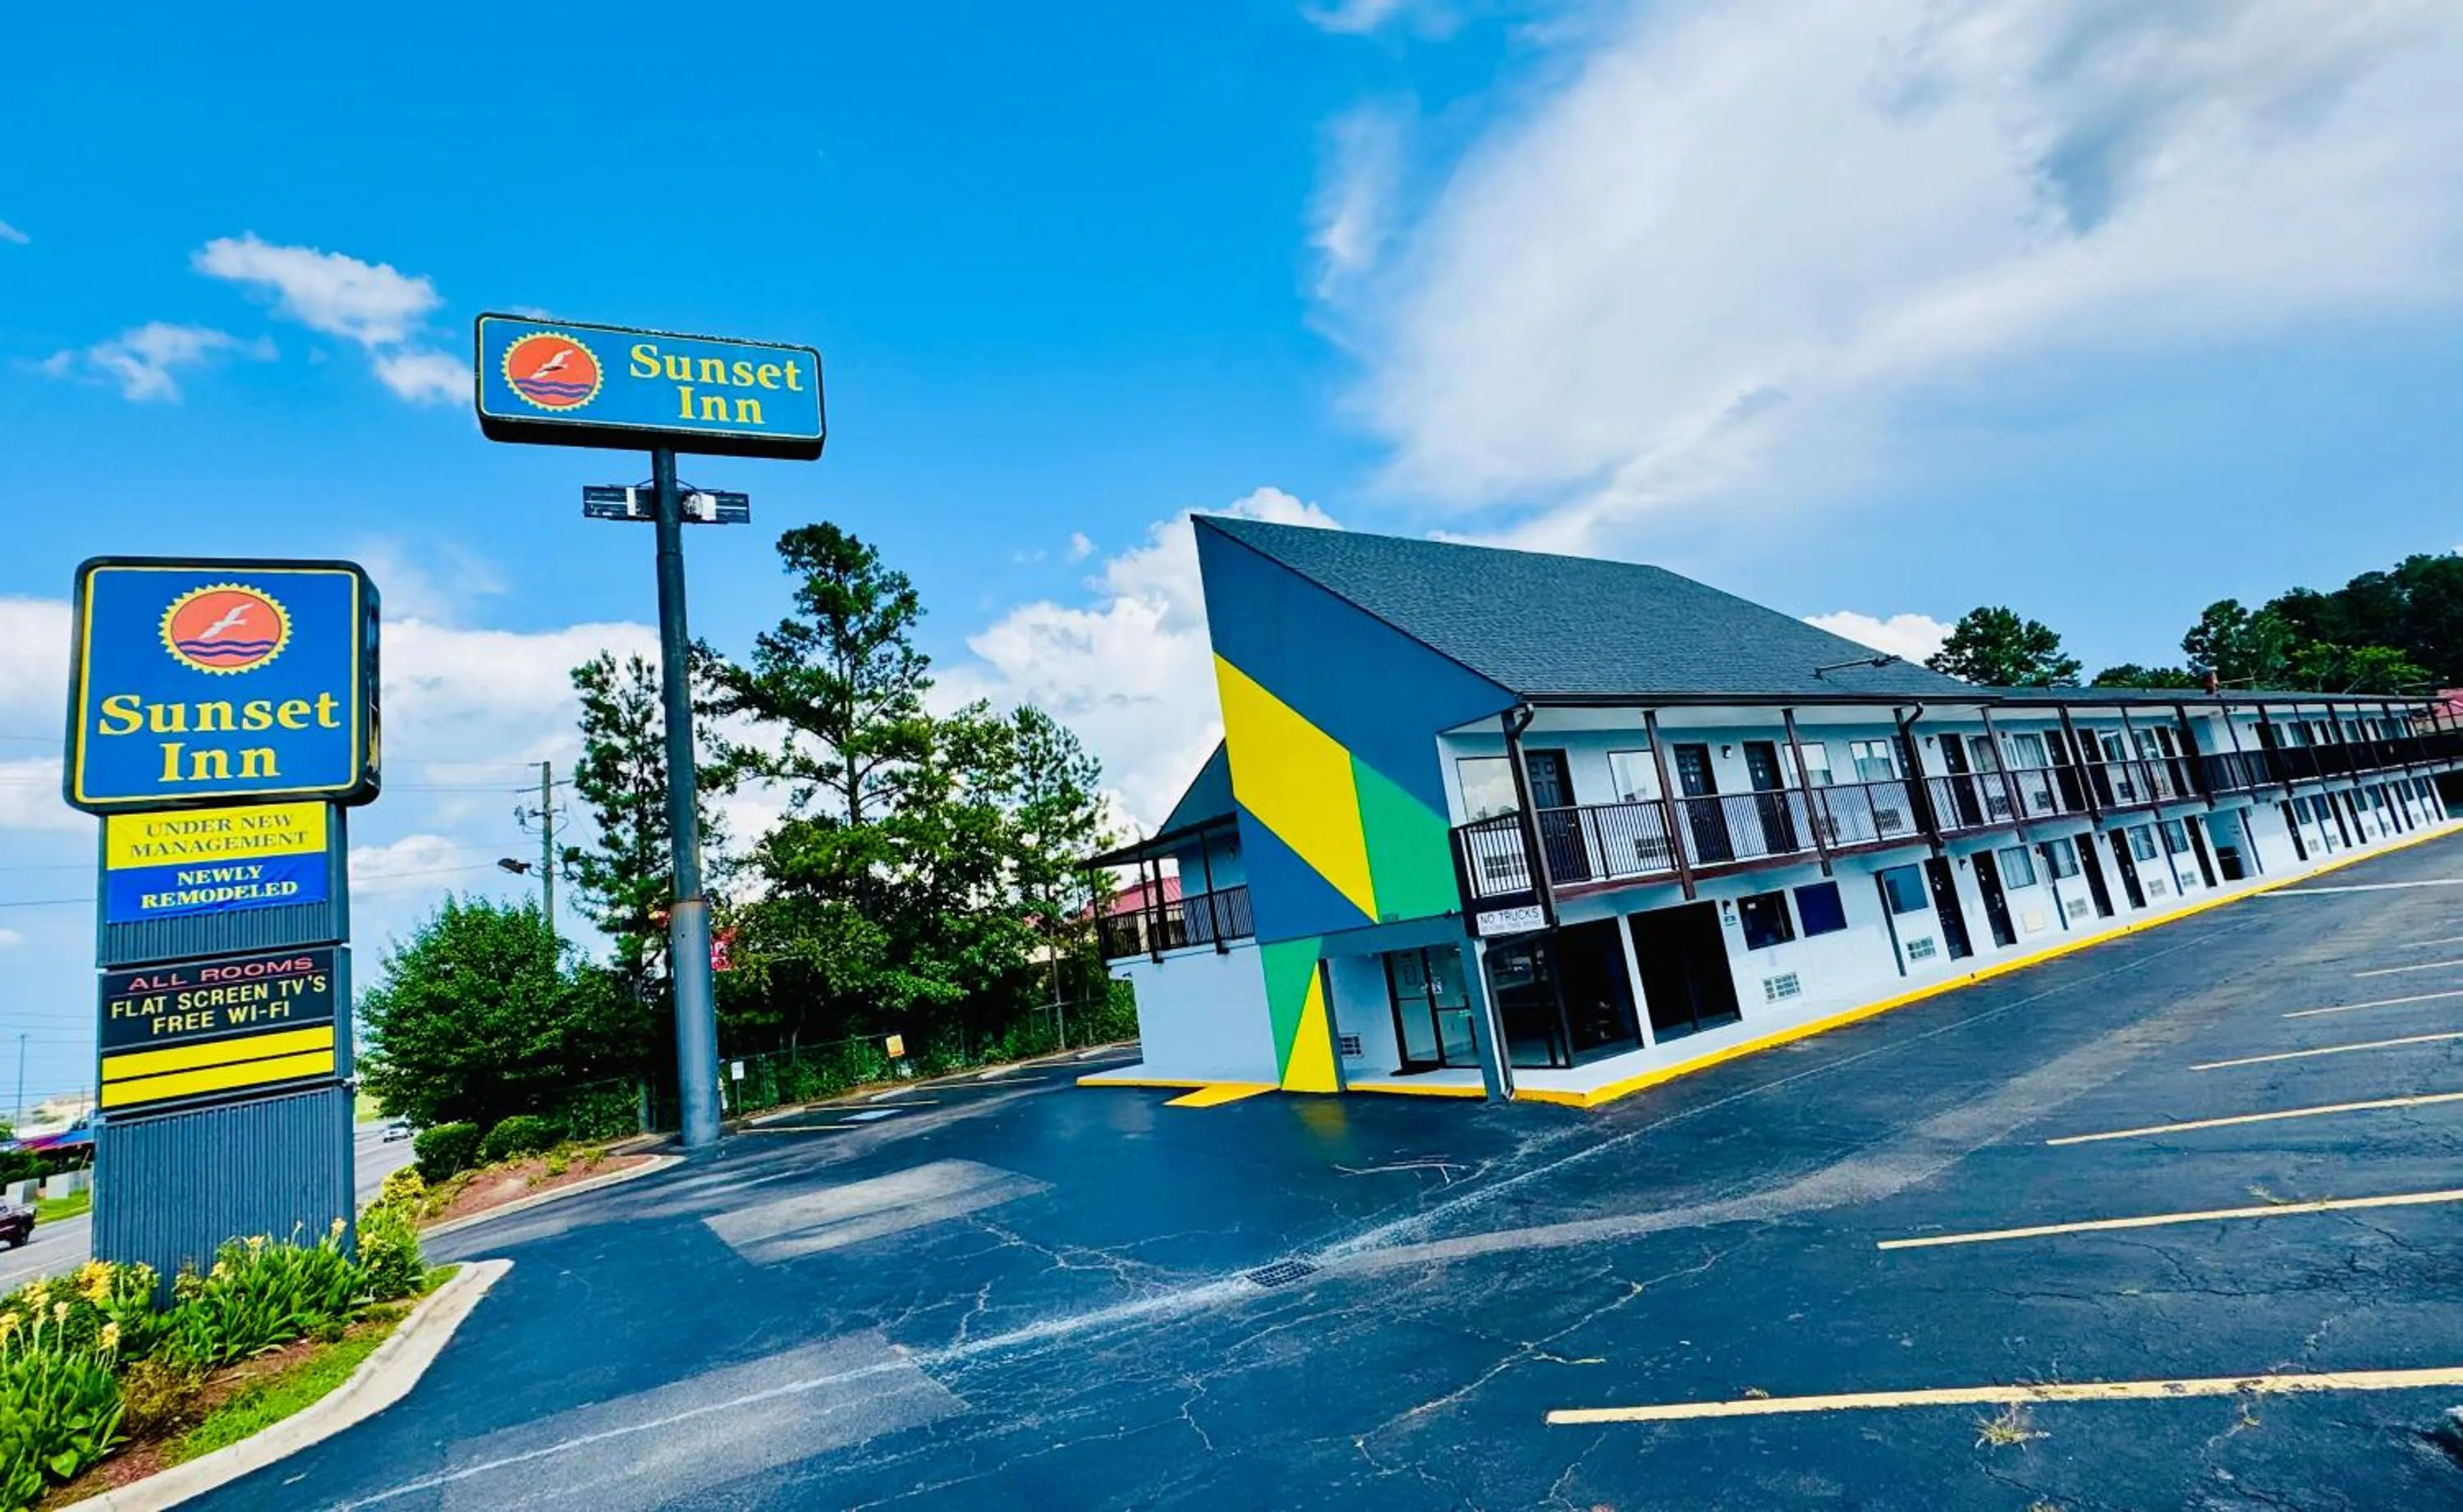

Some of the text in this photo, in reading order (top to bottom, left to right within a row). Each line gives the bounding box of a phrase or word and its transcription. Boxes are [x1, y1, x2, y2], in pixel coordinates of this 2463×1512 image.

[631, 345, 802, 391] Sunset
[678, 387, 764, 424] Inn
[99, 692, 341, 735] Sunset
[158, 742, 281, 781] Inn
[146, 813, 293, 837] UNDER NEW
[131, 832, 309, 858] MANAGEMENT
[177, 865, 264, 886] NEWLY
[141, 882, 298, 909] REMODELED
[1480, 907, 1539, 924] NO TRUCKS
[128, 958, 314, 991] ALL ROOMS
[111, 975, 327, 1019] FLAT SCREEN TV'S
[153, 1001, 290, 1034] FREE WI-FI
